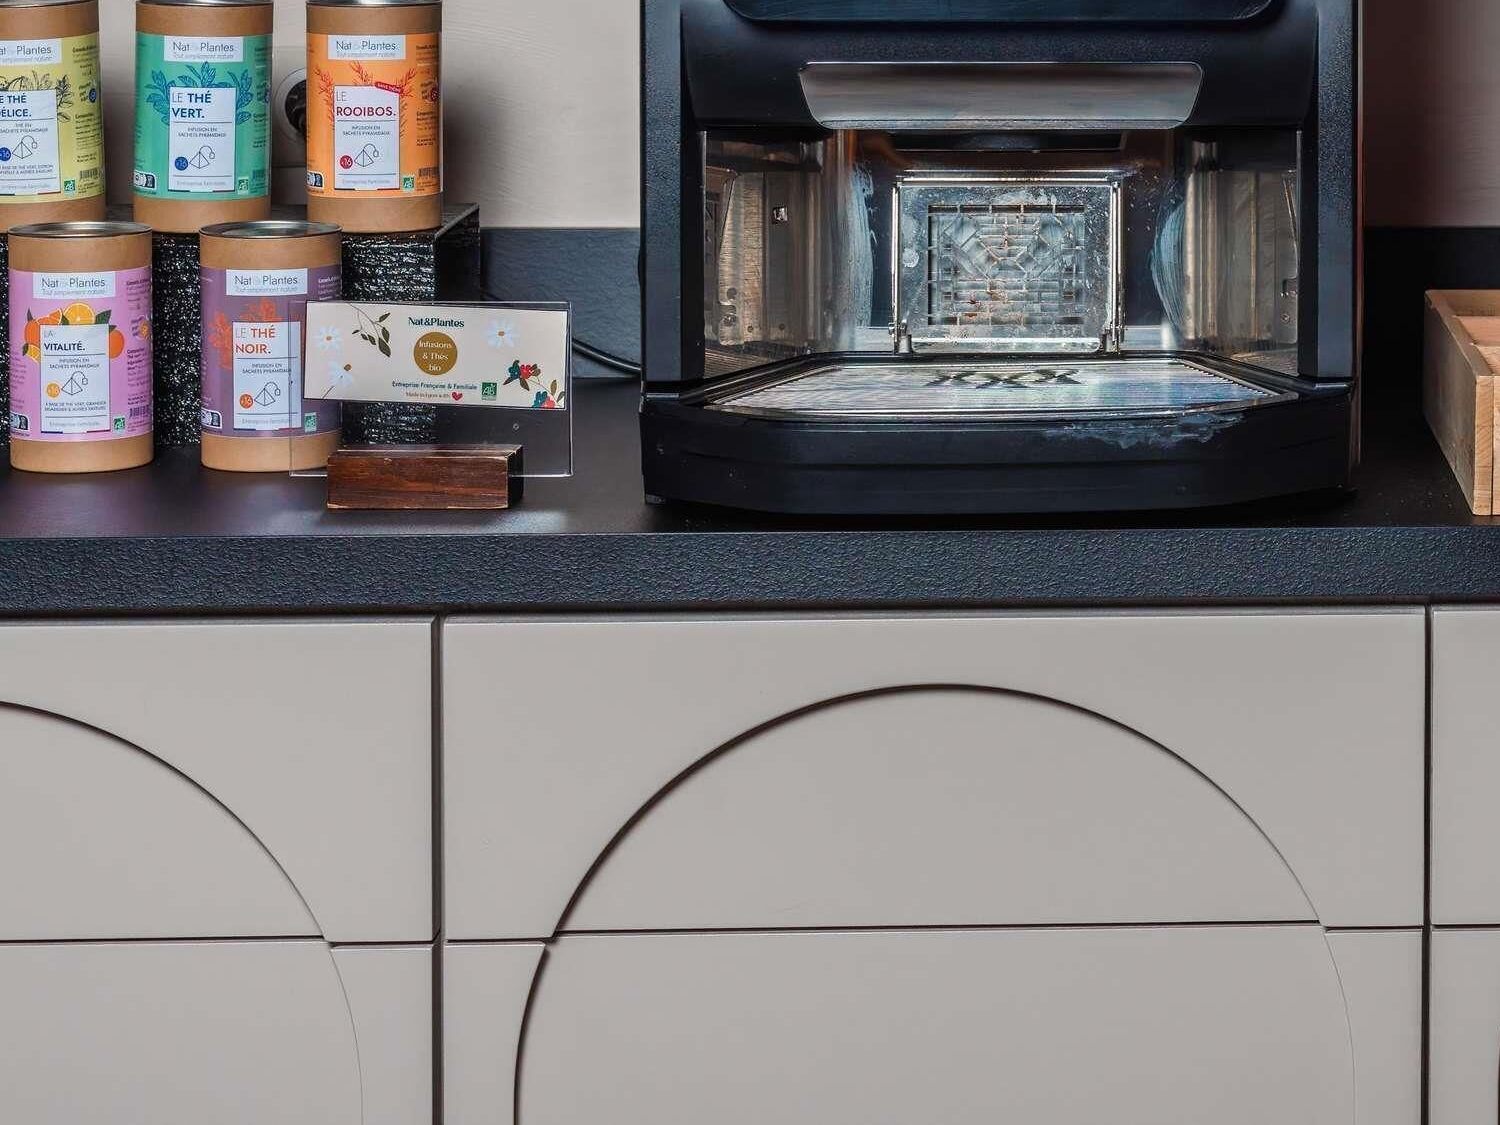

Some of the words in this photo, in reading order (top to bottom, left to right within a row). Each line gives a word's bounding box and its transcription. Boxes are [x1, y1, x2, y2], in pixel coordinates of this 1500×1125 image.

[7, 92, 27, 103] THÉ
[172, 92, 183, 103] LE
[187, 90, 212, 104] THÉ
[336, 91, 346, 102] LE
[0, 107, 32, 117] ÉLICE.
[172, 108, 205, 119] VERT.
[336, 106, 396, 117] ROOIBOS.
[408, 316, 465, 328] Nat&Plantes
[235, 328, 246, 338] LE
[250, 325, 276, 338] THÉ
[44, 340, 86, 351] VITALITÉ.
[235, 343, 272, 354] NOIR.
[418, 340, 453, 349] Infusions
[430, 351, 449, 361] Thés
[428, 363, 442, 372] bio
